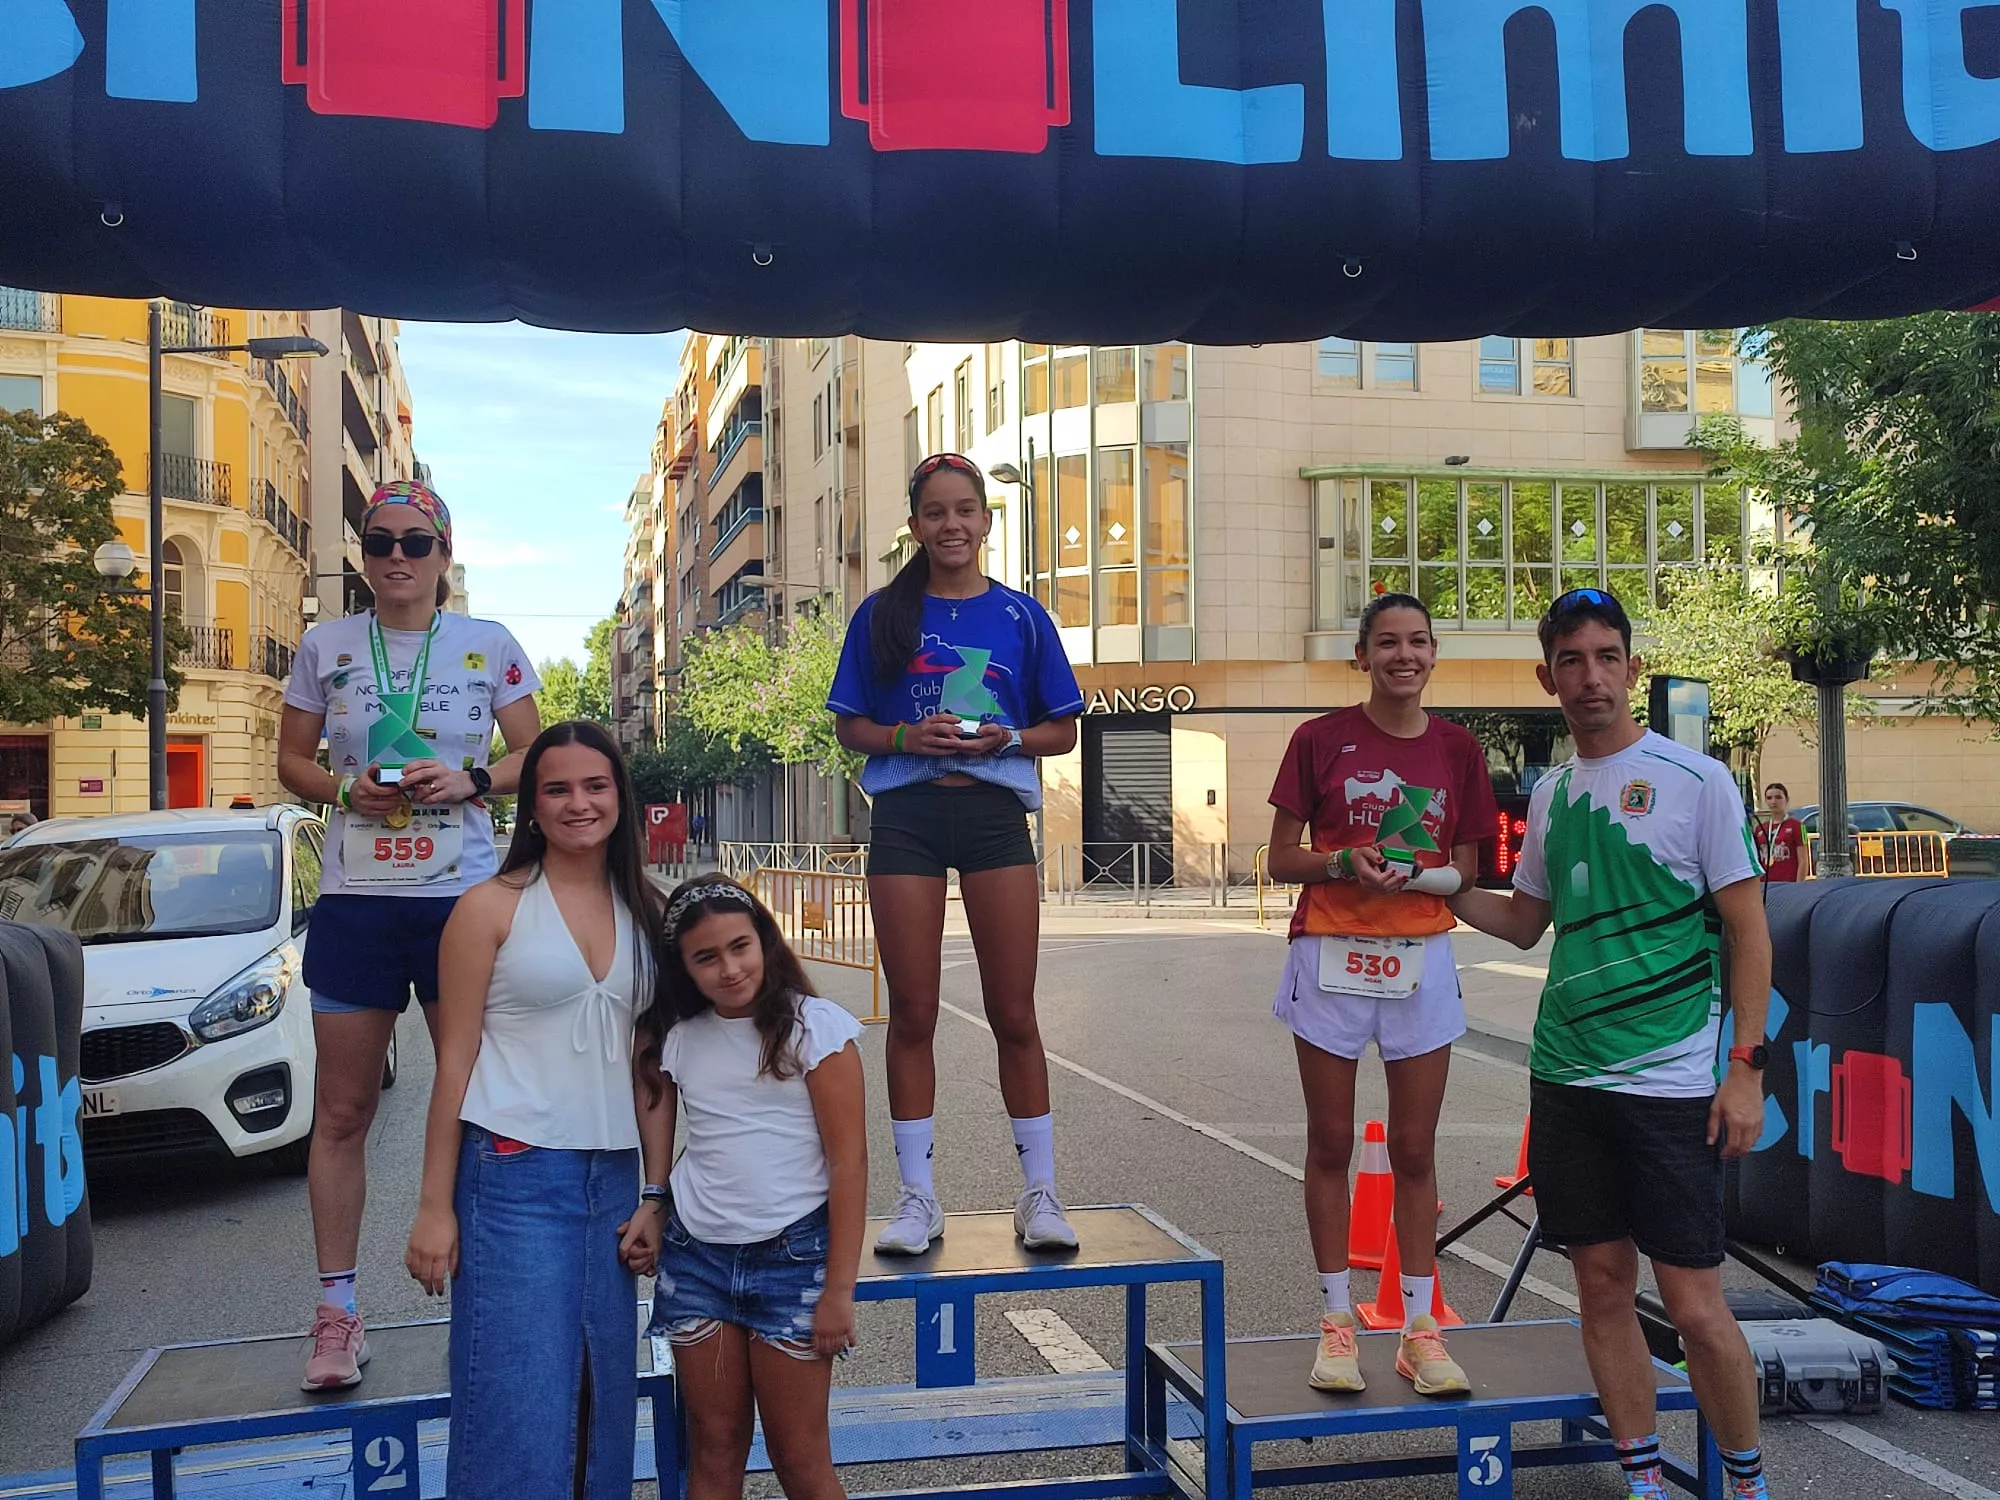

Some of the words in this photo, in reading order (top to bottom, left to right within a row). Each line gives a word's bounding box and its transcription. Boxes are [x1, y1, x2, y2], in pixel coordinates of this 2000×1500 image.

[911, 681, 941, 699] Club
[374, 836, 434, 861] 559
[1345, 952, 1401, 978] 530
[931, 1303, 957, 1354] 1
[365, 1436, 407, 1492] 2
[1468, 1435, 1503, 1486] 3
